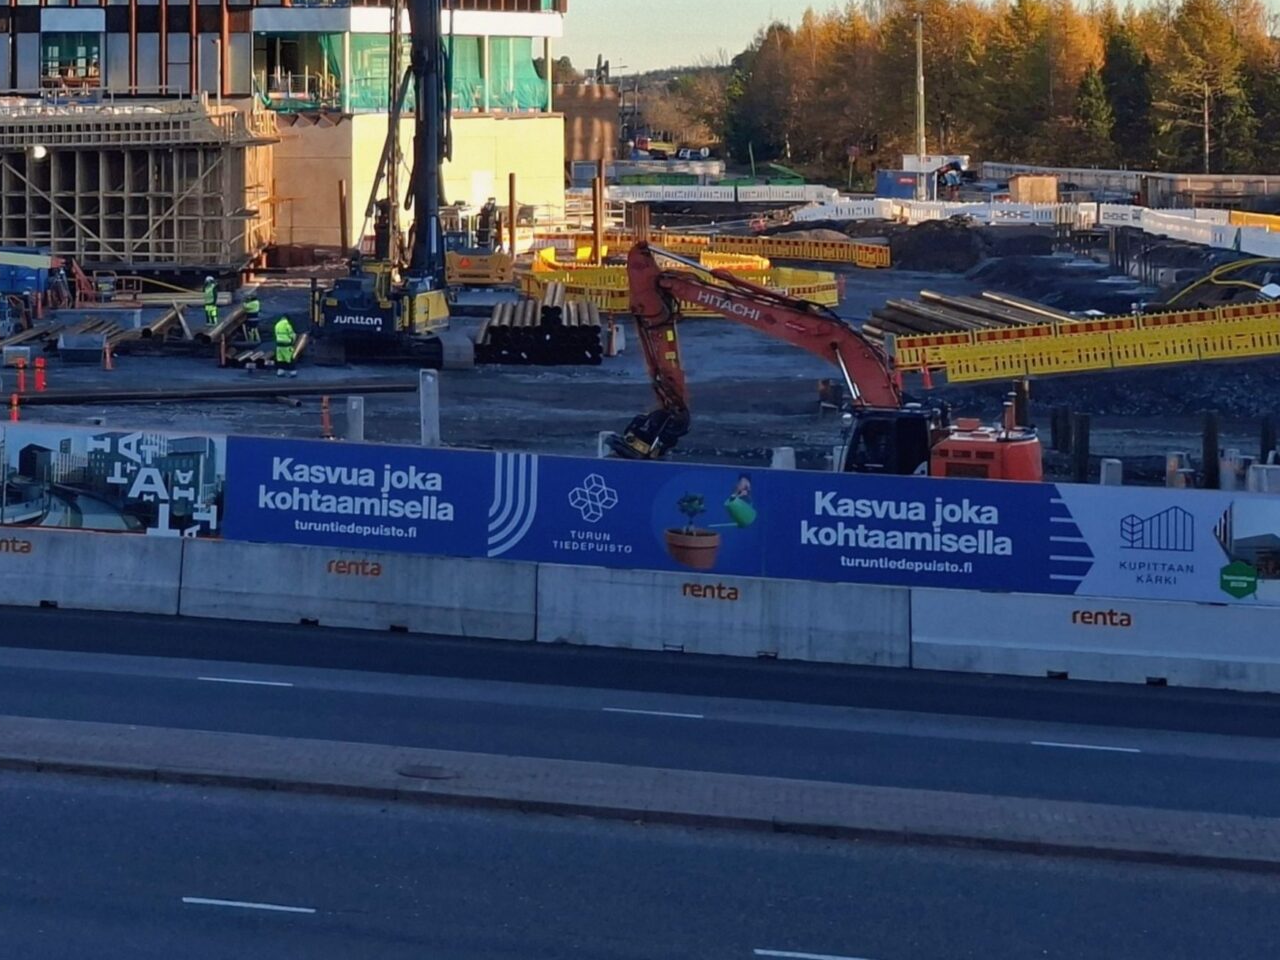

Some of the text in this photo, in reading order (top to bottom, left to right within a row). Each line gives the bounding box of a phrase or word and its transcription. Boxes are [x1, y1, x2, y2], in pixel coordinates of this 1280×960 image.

[697, 291, 761, 321] HITACHI
[272, 457, 442, 492] Kasvua joka
[258, 485, 454, 521] kohtaamisella
[814, 491, 999, 527] Kasvua joka
[294, 519, 417, 538] turuntiedepuisto.fi
[570, 530, 610, 541] TURUN
[801, 520, 1013, 555] kohtaamisella
[552, 540, 632, 554] TIEDEPUISTO
[327, 559, 381, 576] renta
[840, 555, 972, 574] turuntiedepuisto.fi
[1119, 561, 1195, 573] KUPITTAAN
[1136, 574, 1177, 585] KÄRKI
[683, 582, 738, 601] renta
[1072, 609, 1132, 627] renta
